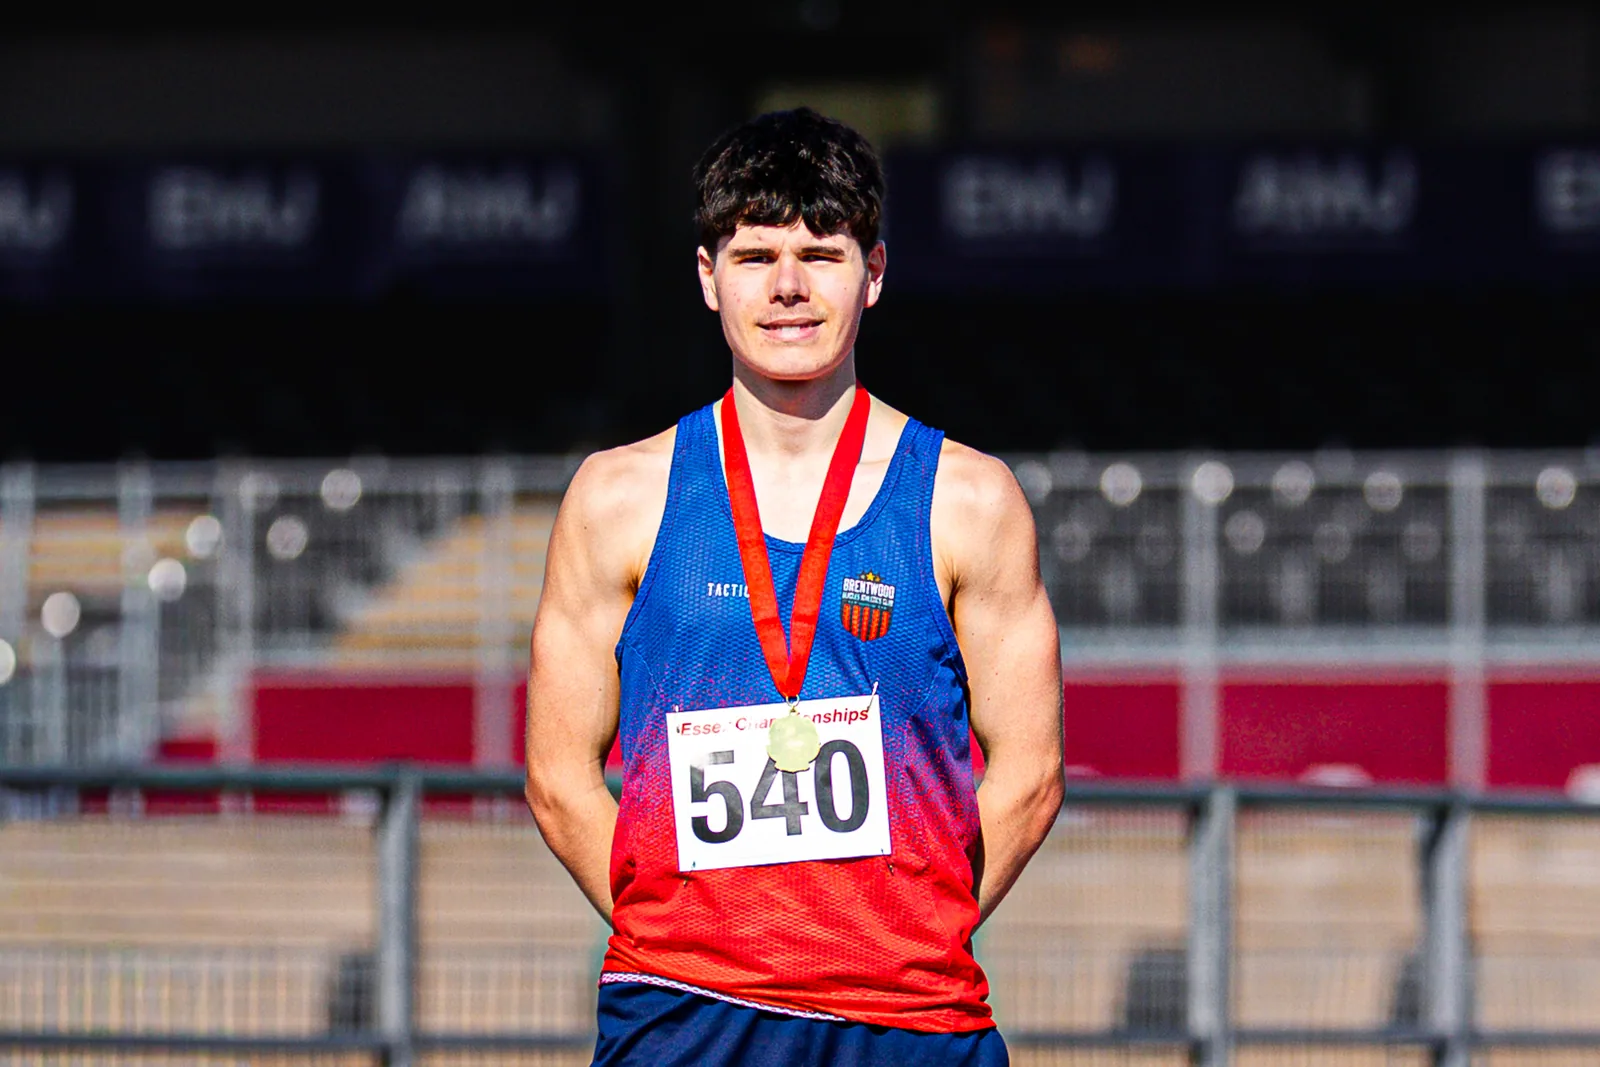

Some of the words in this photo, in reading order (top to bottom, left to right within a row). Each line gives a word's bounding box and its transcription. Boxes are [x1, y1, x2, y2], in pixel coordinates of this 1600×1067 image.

[843, 578, 895, 599] BRENTWOOD
[681, 722, 731, 736] Esse
[689, 739, 870, 844] 540
